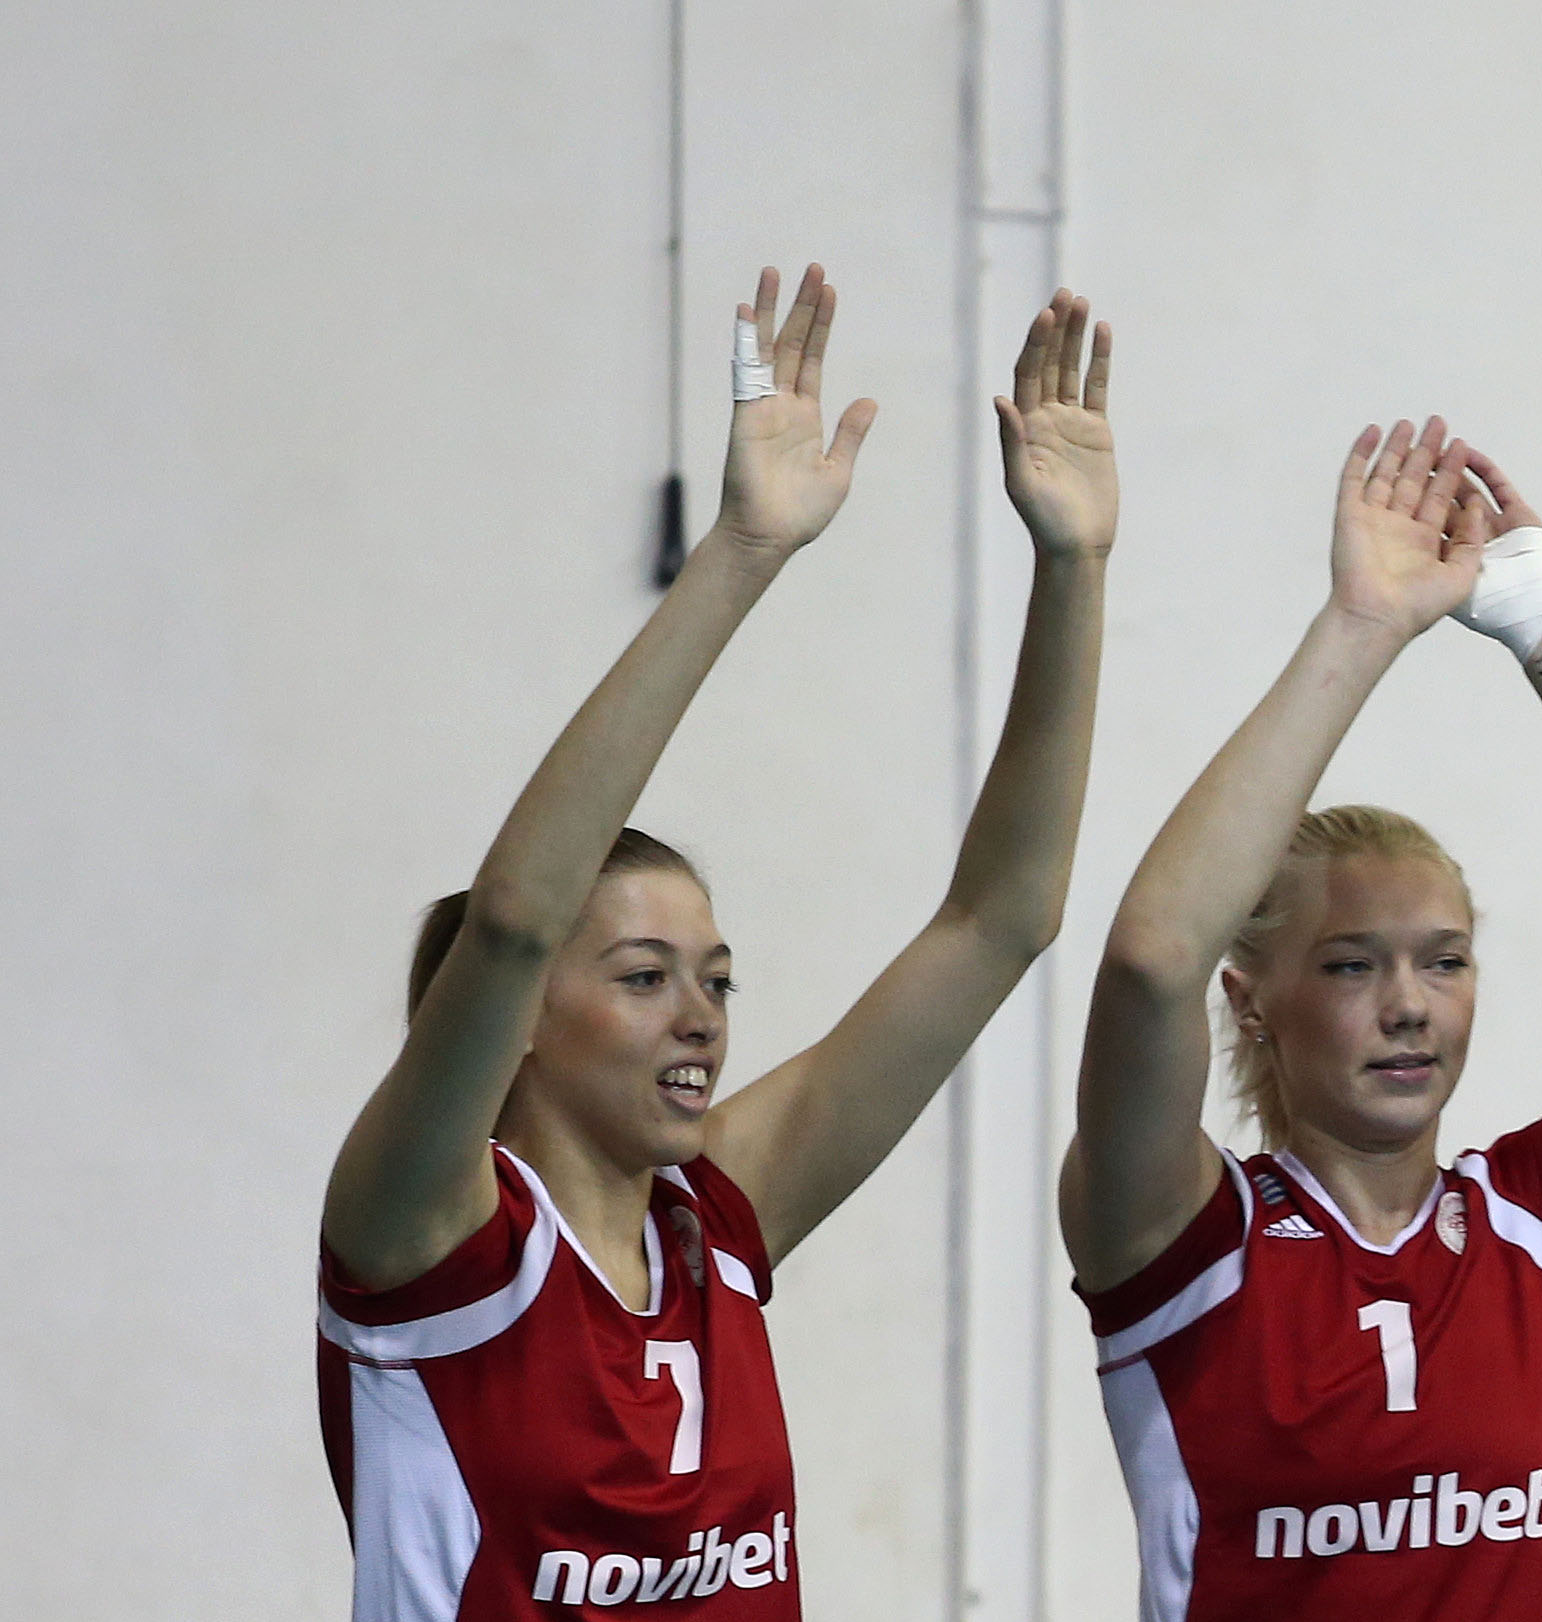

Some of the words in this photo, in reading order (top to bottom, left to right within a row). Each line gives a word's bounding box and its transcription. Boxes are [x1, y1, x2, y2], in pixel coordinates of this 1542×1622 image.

[643, 1340, 703, 1475] 7
[1358, 1300, 1417, 1412] 1
[533, 1511, 796, 1607] novibet
